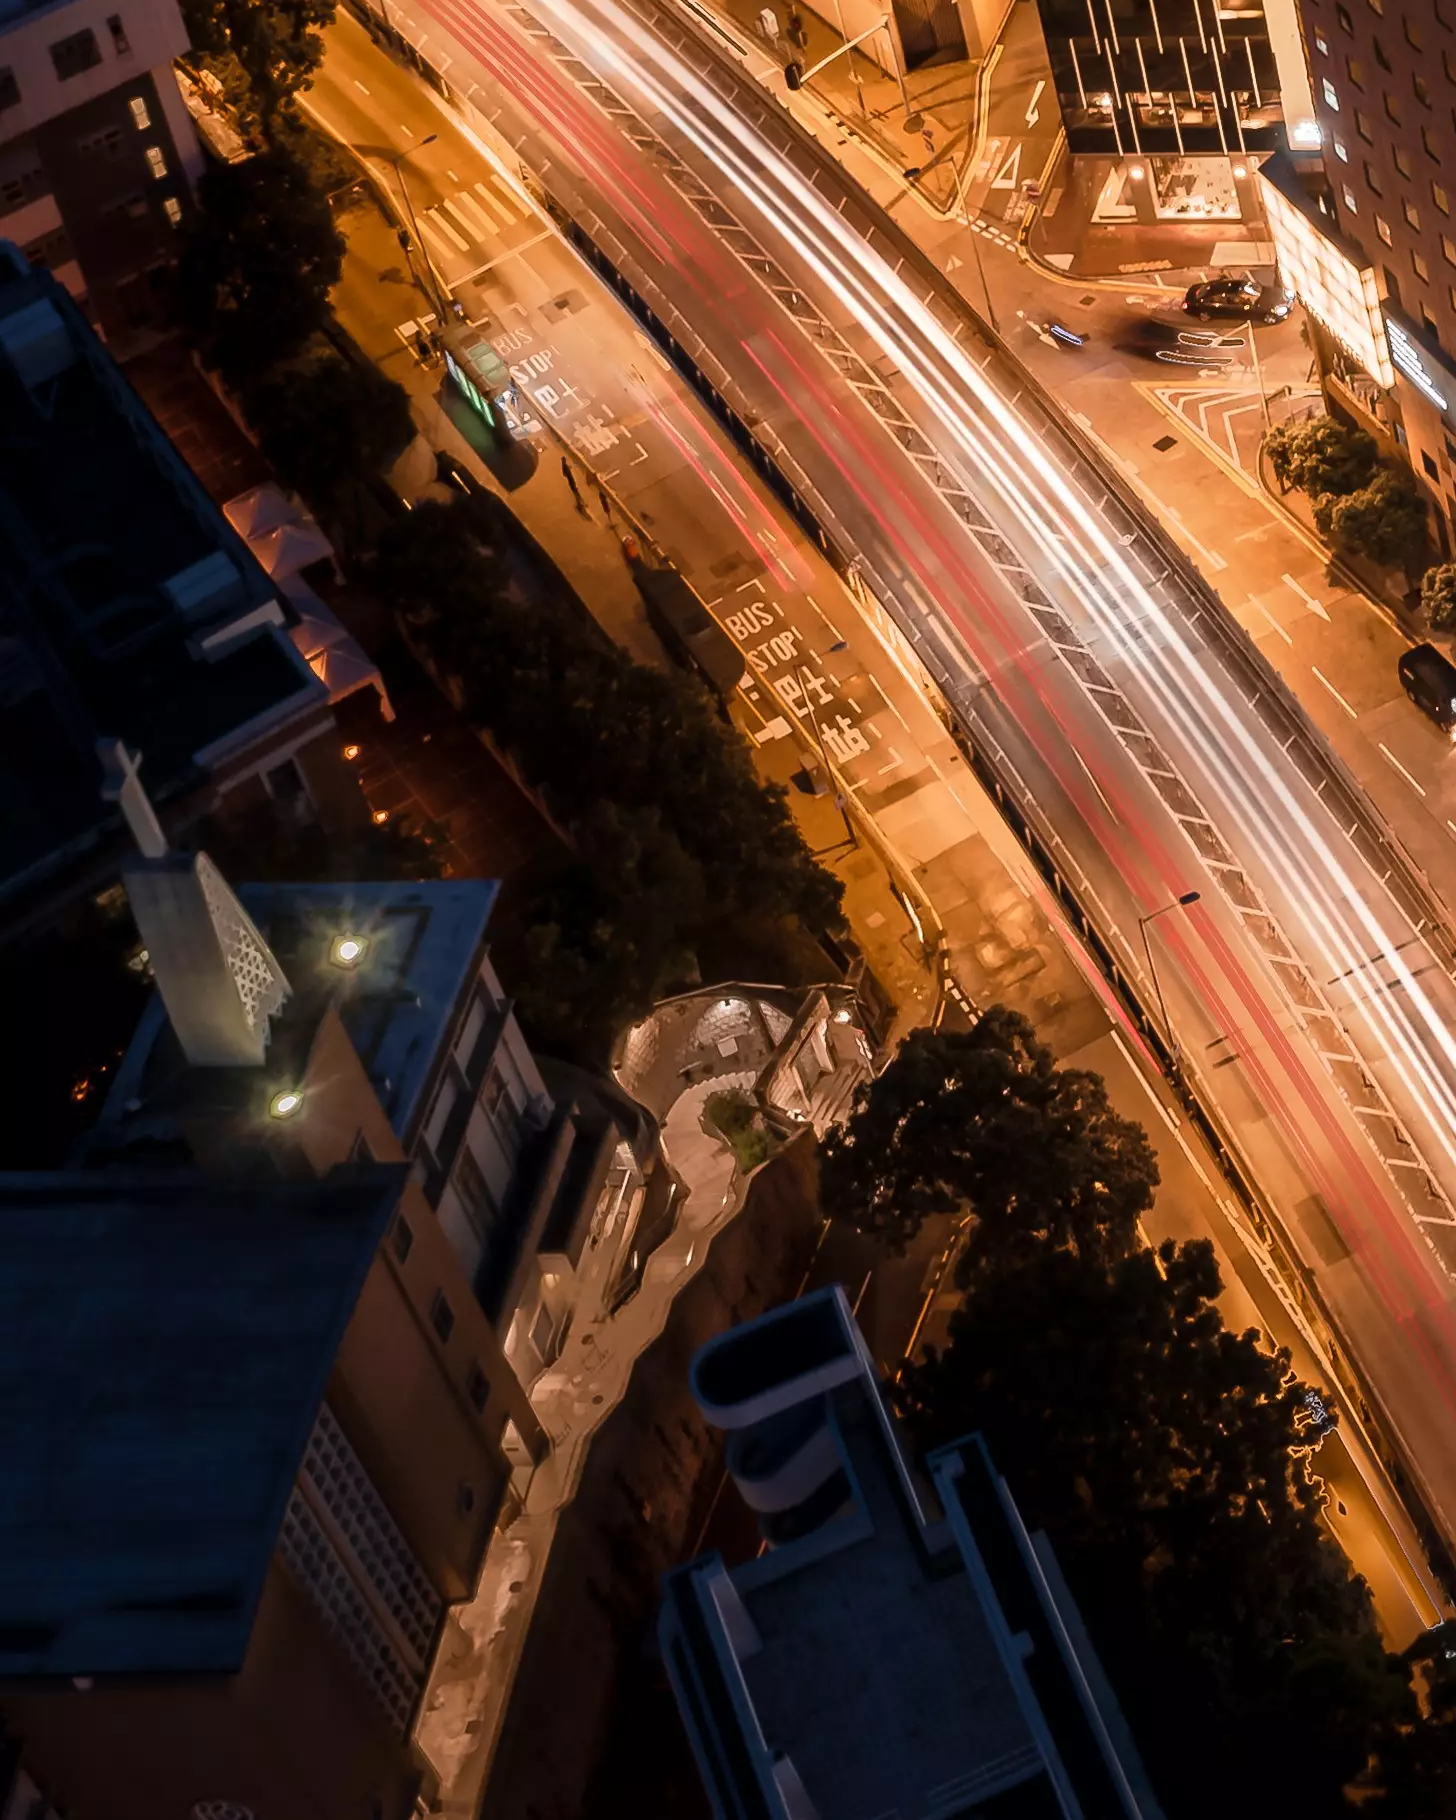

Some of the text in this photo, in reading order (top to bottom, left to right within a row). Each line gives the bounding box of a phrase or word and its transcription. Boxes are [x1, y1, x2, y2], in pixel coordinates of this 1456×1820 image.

[490, 326, 533, 357] BUS
[508, 349, 555, 386] STOP
[534, 377, 591, 420] 巴士
[724, 601, 774, 642] BUS
[746, 630, 799, 673] STOP
[773, 664, 835, 719] 巴士
[821, 714, 871, 765] 站
